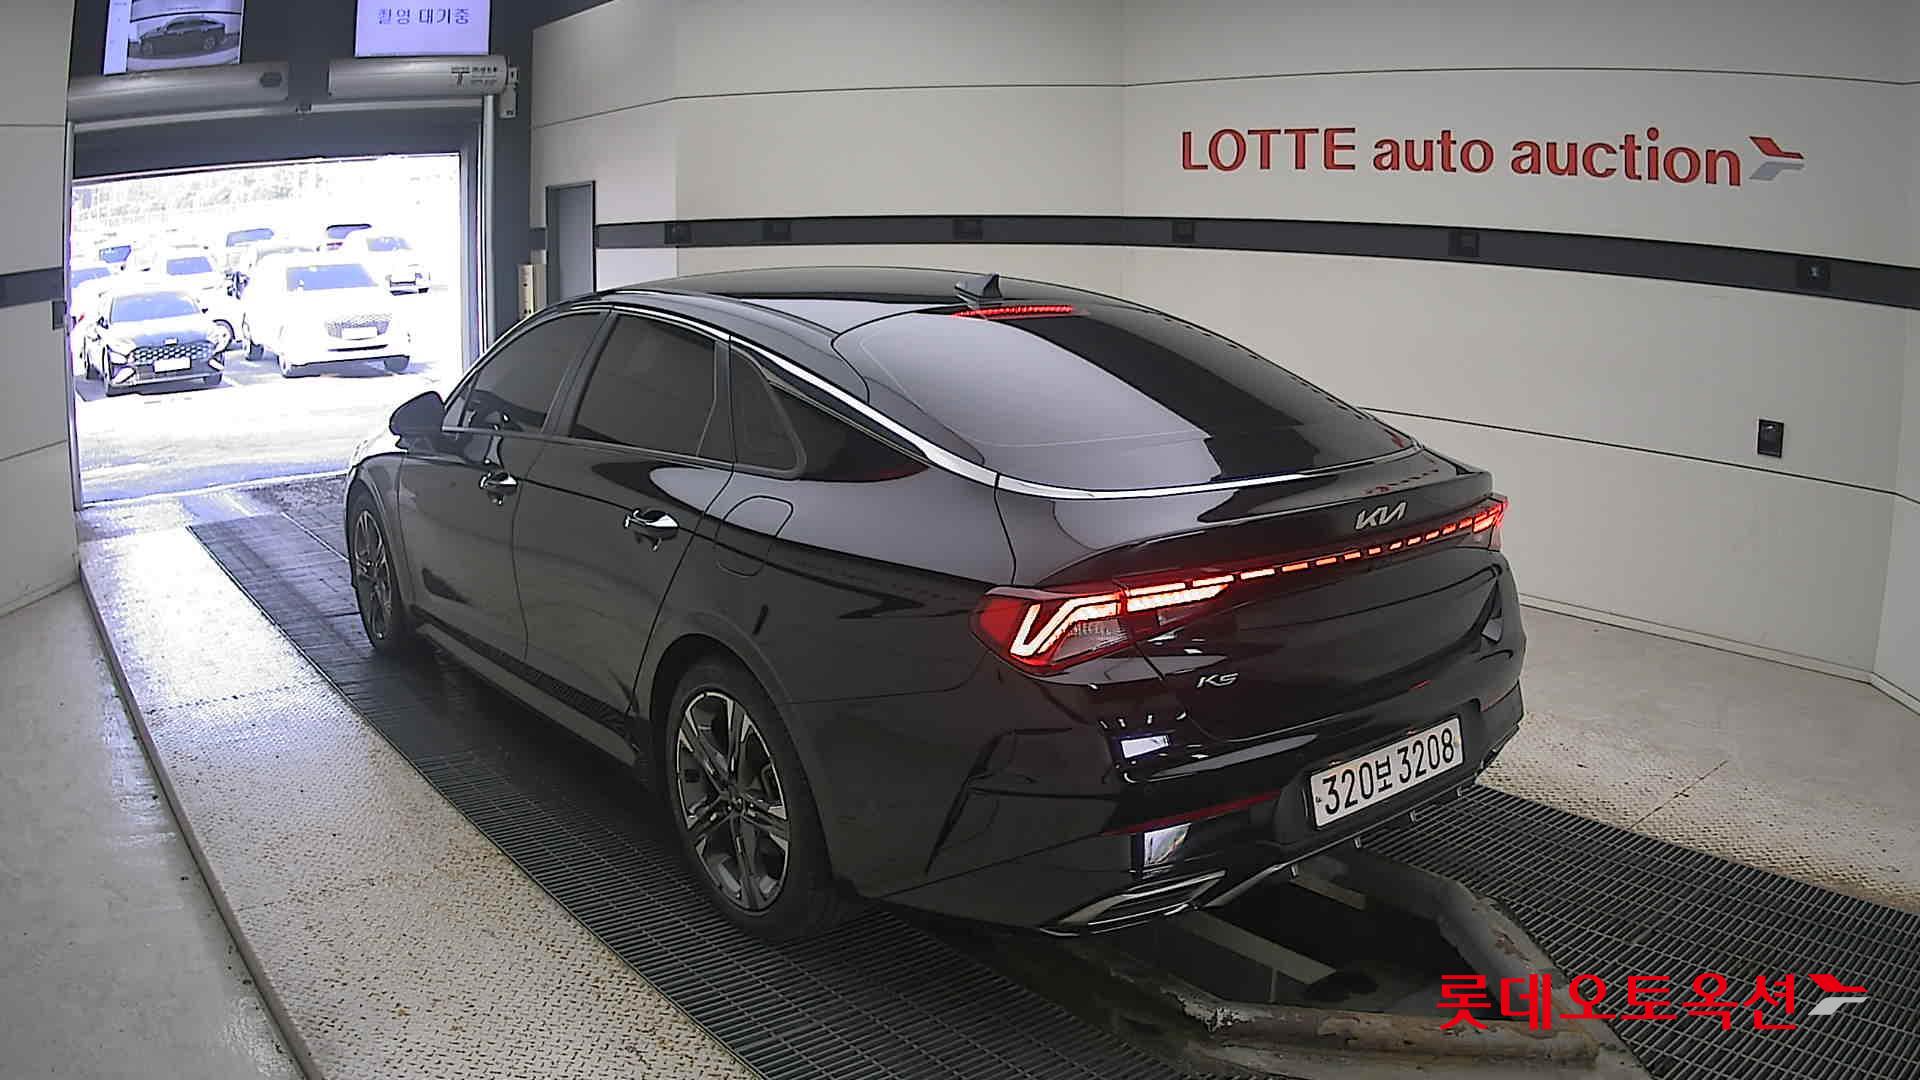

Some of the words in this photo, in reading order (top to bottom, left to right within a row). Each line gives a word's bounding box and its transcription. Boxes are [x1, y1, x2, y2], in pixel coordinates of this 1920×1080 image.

[418, 7, 471, 25] 대기중
[1181, 126, 1357, 172] LOTTE
[1373, 130, 1494, 173] auto
[1511, 127, 1743, 187] auction
[1197, 672, 1240, 689] K5
[1322, 755, 1394, 815] 320보
[1396, 727, 1456, 784] 3208
